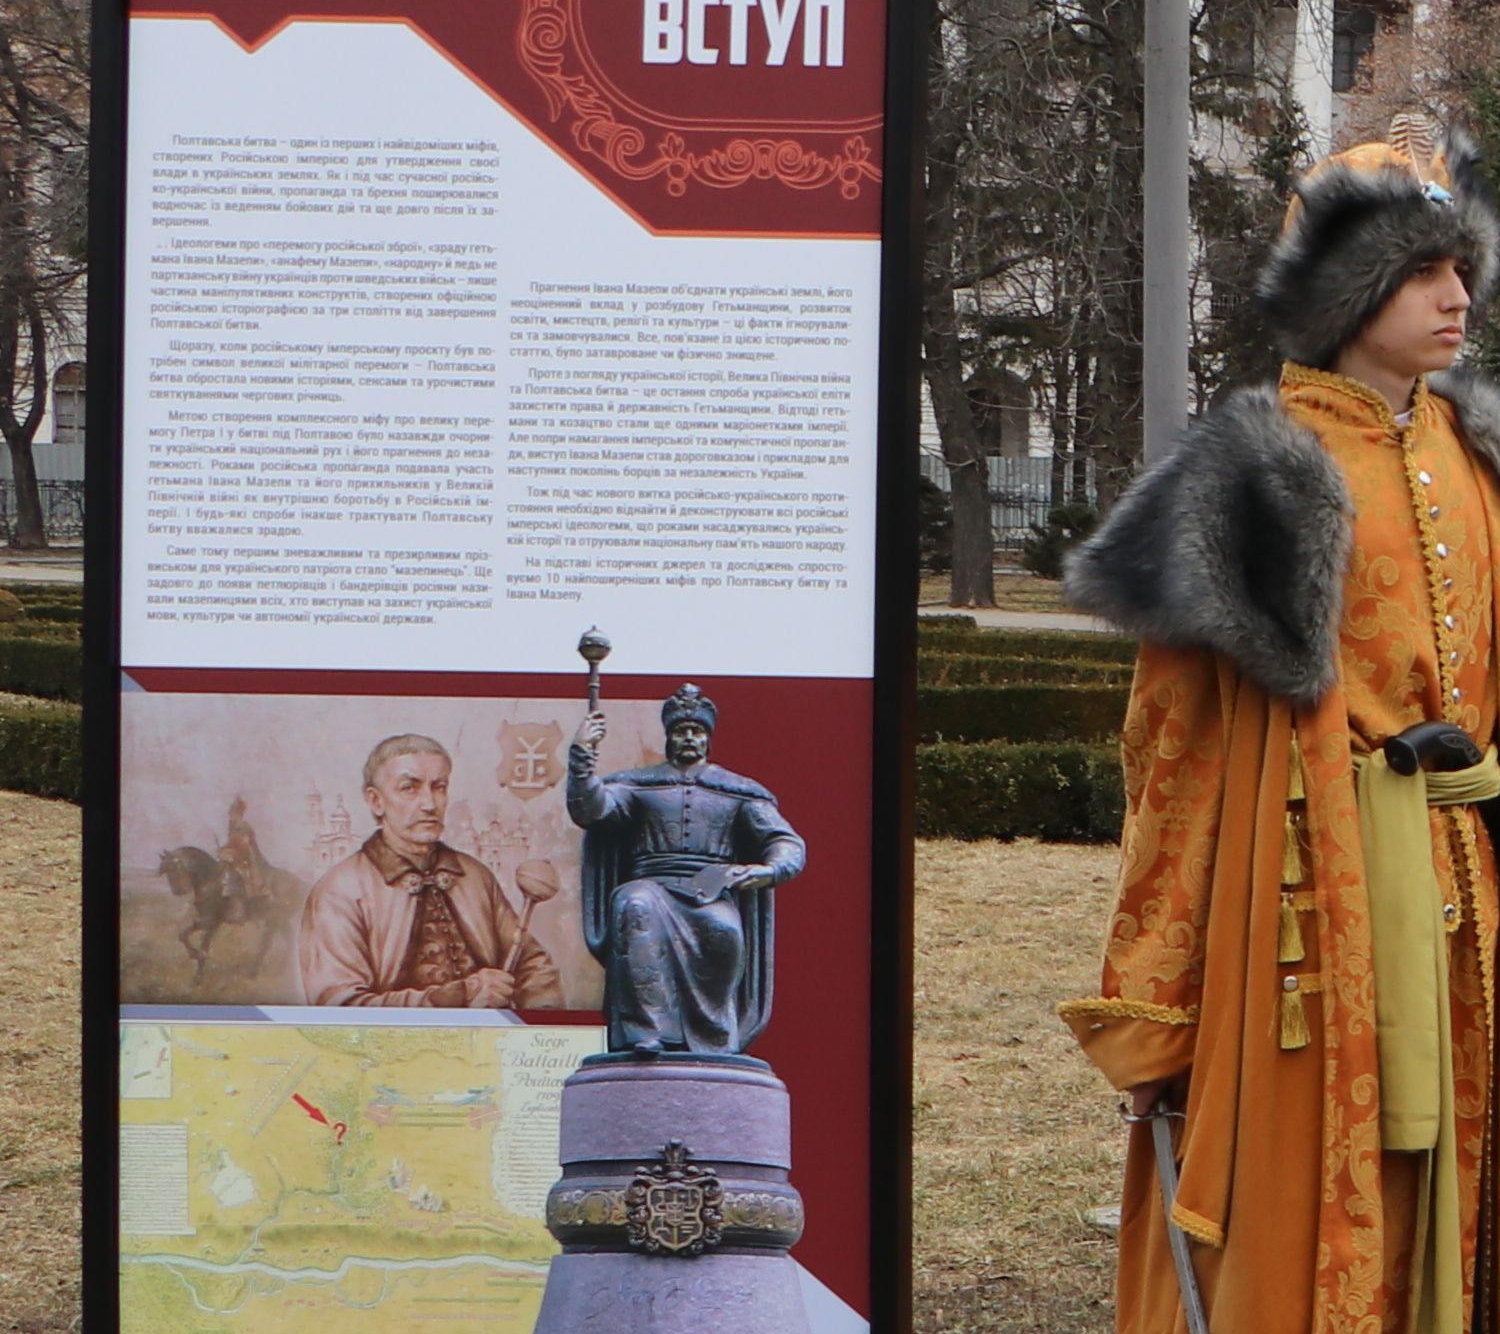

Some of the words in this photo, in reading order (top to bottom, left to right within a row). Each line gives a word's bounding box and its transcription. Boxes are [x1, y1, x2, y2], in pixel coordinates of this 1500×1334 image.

[171, 134, 241, 146] Полтавська
[242, 135, 277, 147] битва
[289, 139, 318, 149] один
[319, 139, 330, 147] із
[331, 139, 375, 151] перших
[382, 138, 463, 151] найвідоміших
[464, 139, 499, 153] міфів,
[151, 152, 213, 164] створених
[220, 151, 289, 163] Російською
[296, 153, 349, 166] імперією
[355, 156, 378, 166] для
[384, 156, 462, 168] утвердження
[468, 157, 500, 167] своєї
[151, 168, 188, 179] влади
[201, 168, 273, 181] українських
[325, 169, 341, 180] Як
[351, 172, 371, 182] під
[373, 172, 394, 181] час
[397, 173, 448, 185] сучасної
[450, 171, 498, 185] російсь-
[151, 183, 237, 197] ко-української
[240, 184, 276, 196] війни,
[278, 186, 347, 199] пропаганда
[350, 188, 364, 196] та
[366, 186, 408, 200] брехня
[410, 189, 499, 201] поширювалися
[150, 200, 207, 211] водночас
[210, 202, 221, 210] із
[223, 202, 281, 213] веденням
[284, 201, 333, 212] бойових
[336, 202, 355, 214] дій
[358, 204, 372, 213] та
[374, 205, 393, 215] ще
[395, 205, 430, 215] довго
[432, 206, 464, 214] після
[466, 205, 477, 214] їх
[480, 206, 498, 215] за-
[151, 217, 212, 228] вершення.
[525, 556, 541, 567] На
[544, 558, 592, 569] підставі
[595, 559, 658, 571] історичних
[661, 560, 706, 572] джерел
[709, 561, 722, 569] та
[726, 561, 794, 572] досліджень
[797, 562, 847, 574] спросто-
[505, 574, 541, 585] вуємо
[546, 572, 560, 583] 10
[564, 572, 661, 587] найпоширеніших
[665, 574, 697, 587] міфів
[700, 577, 722, 588] про
[725, 575, 794, 589] Полтавську
[797, 576, 831, 589] битву
[834, 579, 848, 588] та
[505, 588, 537, 599] Івана
[539, 588, 584, 602] Мазепу.
